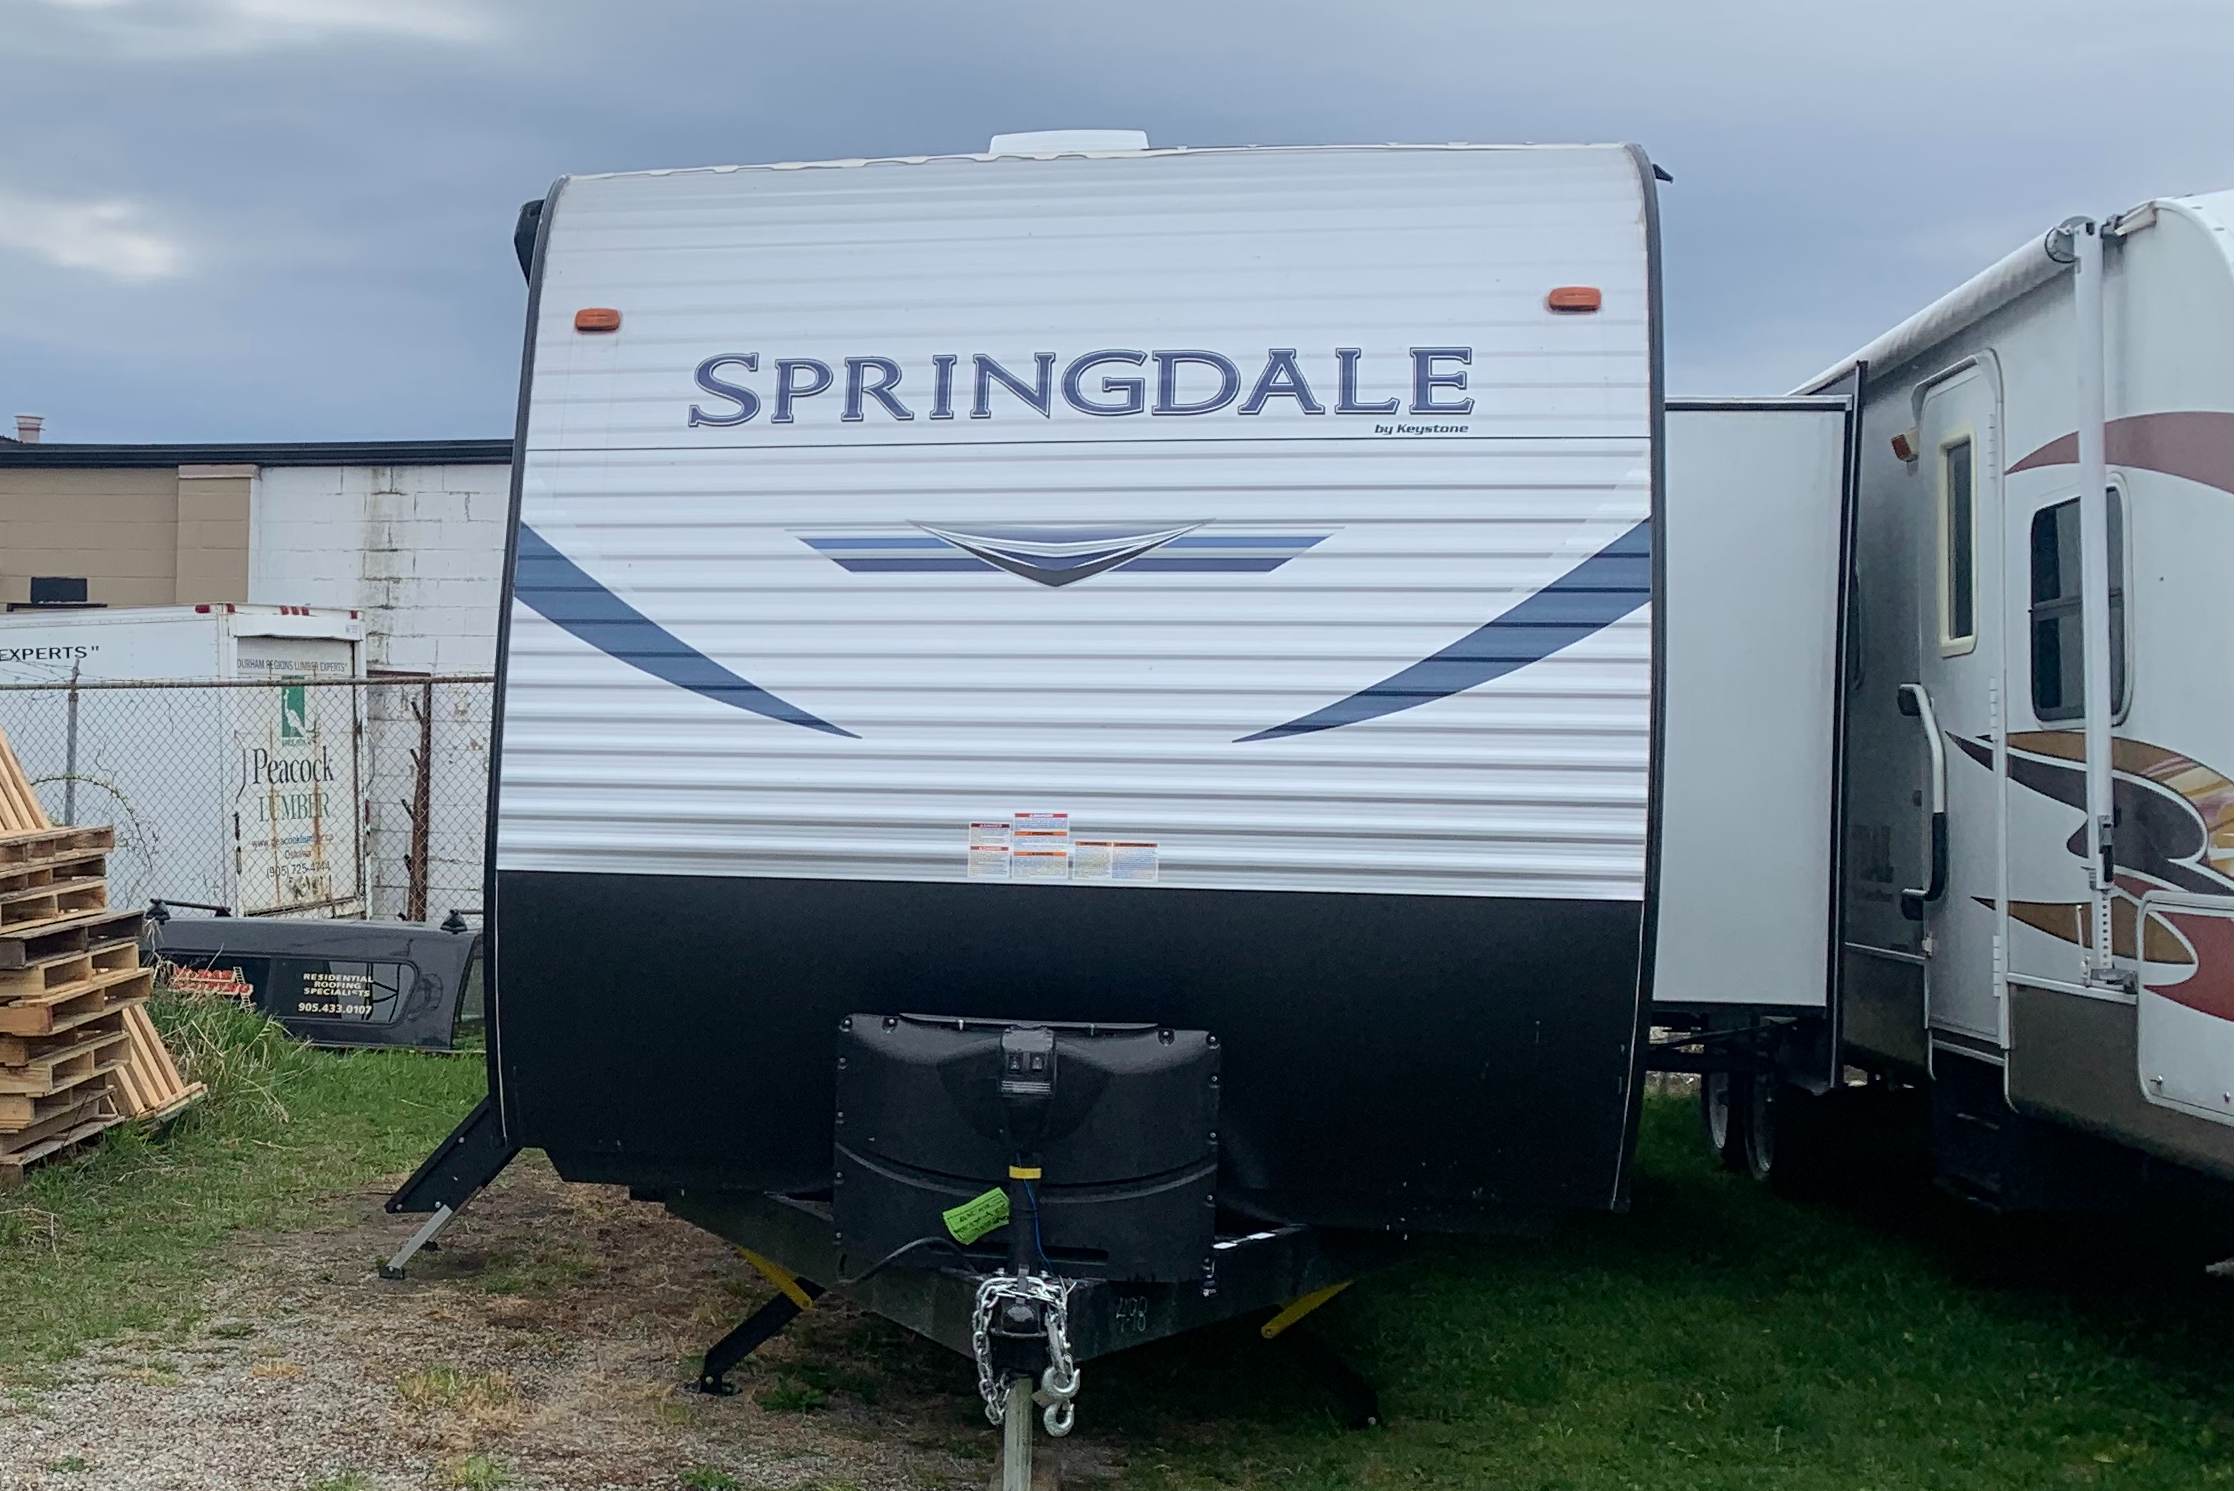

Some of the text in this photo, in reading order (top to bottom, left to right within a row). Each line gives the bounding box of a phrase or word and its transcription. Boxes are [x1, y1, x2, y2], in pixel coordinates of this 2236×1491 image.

[688, 347, 1475, 428] SPRINGDALE
[1374, 424, 1469, 435] by Keystone
[237, 658, 265, 669] DURHAM
[266, 660, 293, 670] REGIONS
[294, 661, 319, 671] LUMBER
[252, 745, 335, 785] Peacock
[258, 792, 330, 823] LUMBER
[303, 973, 374, 983] RESIDENTIAL
[314, 981, 362, 989] ROOFING
[303, 987, 371, 997] SPECIALISTS
[298, 1002, 372, 1014] 905.433.0107
